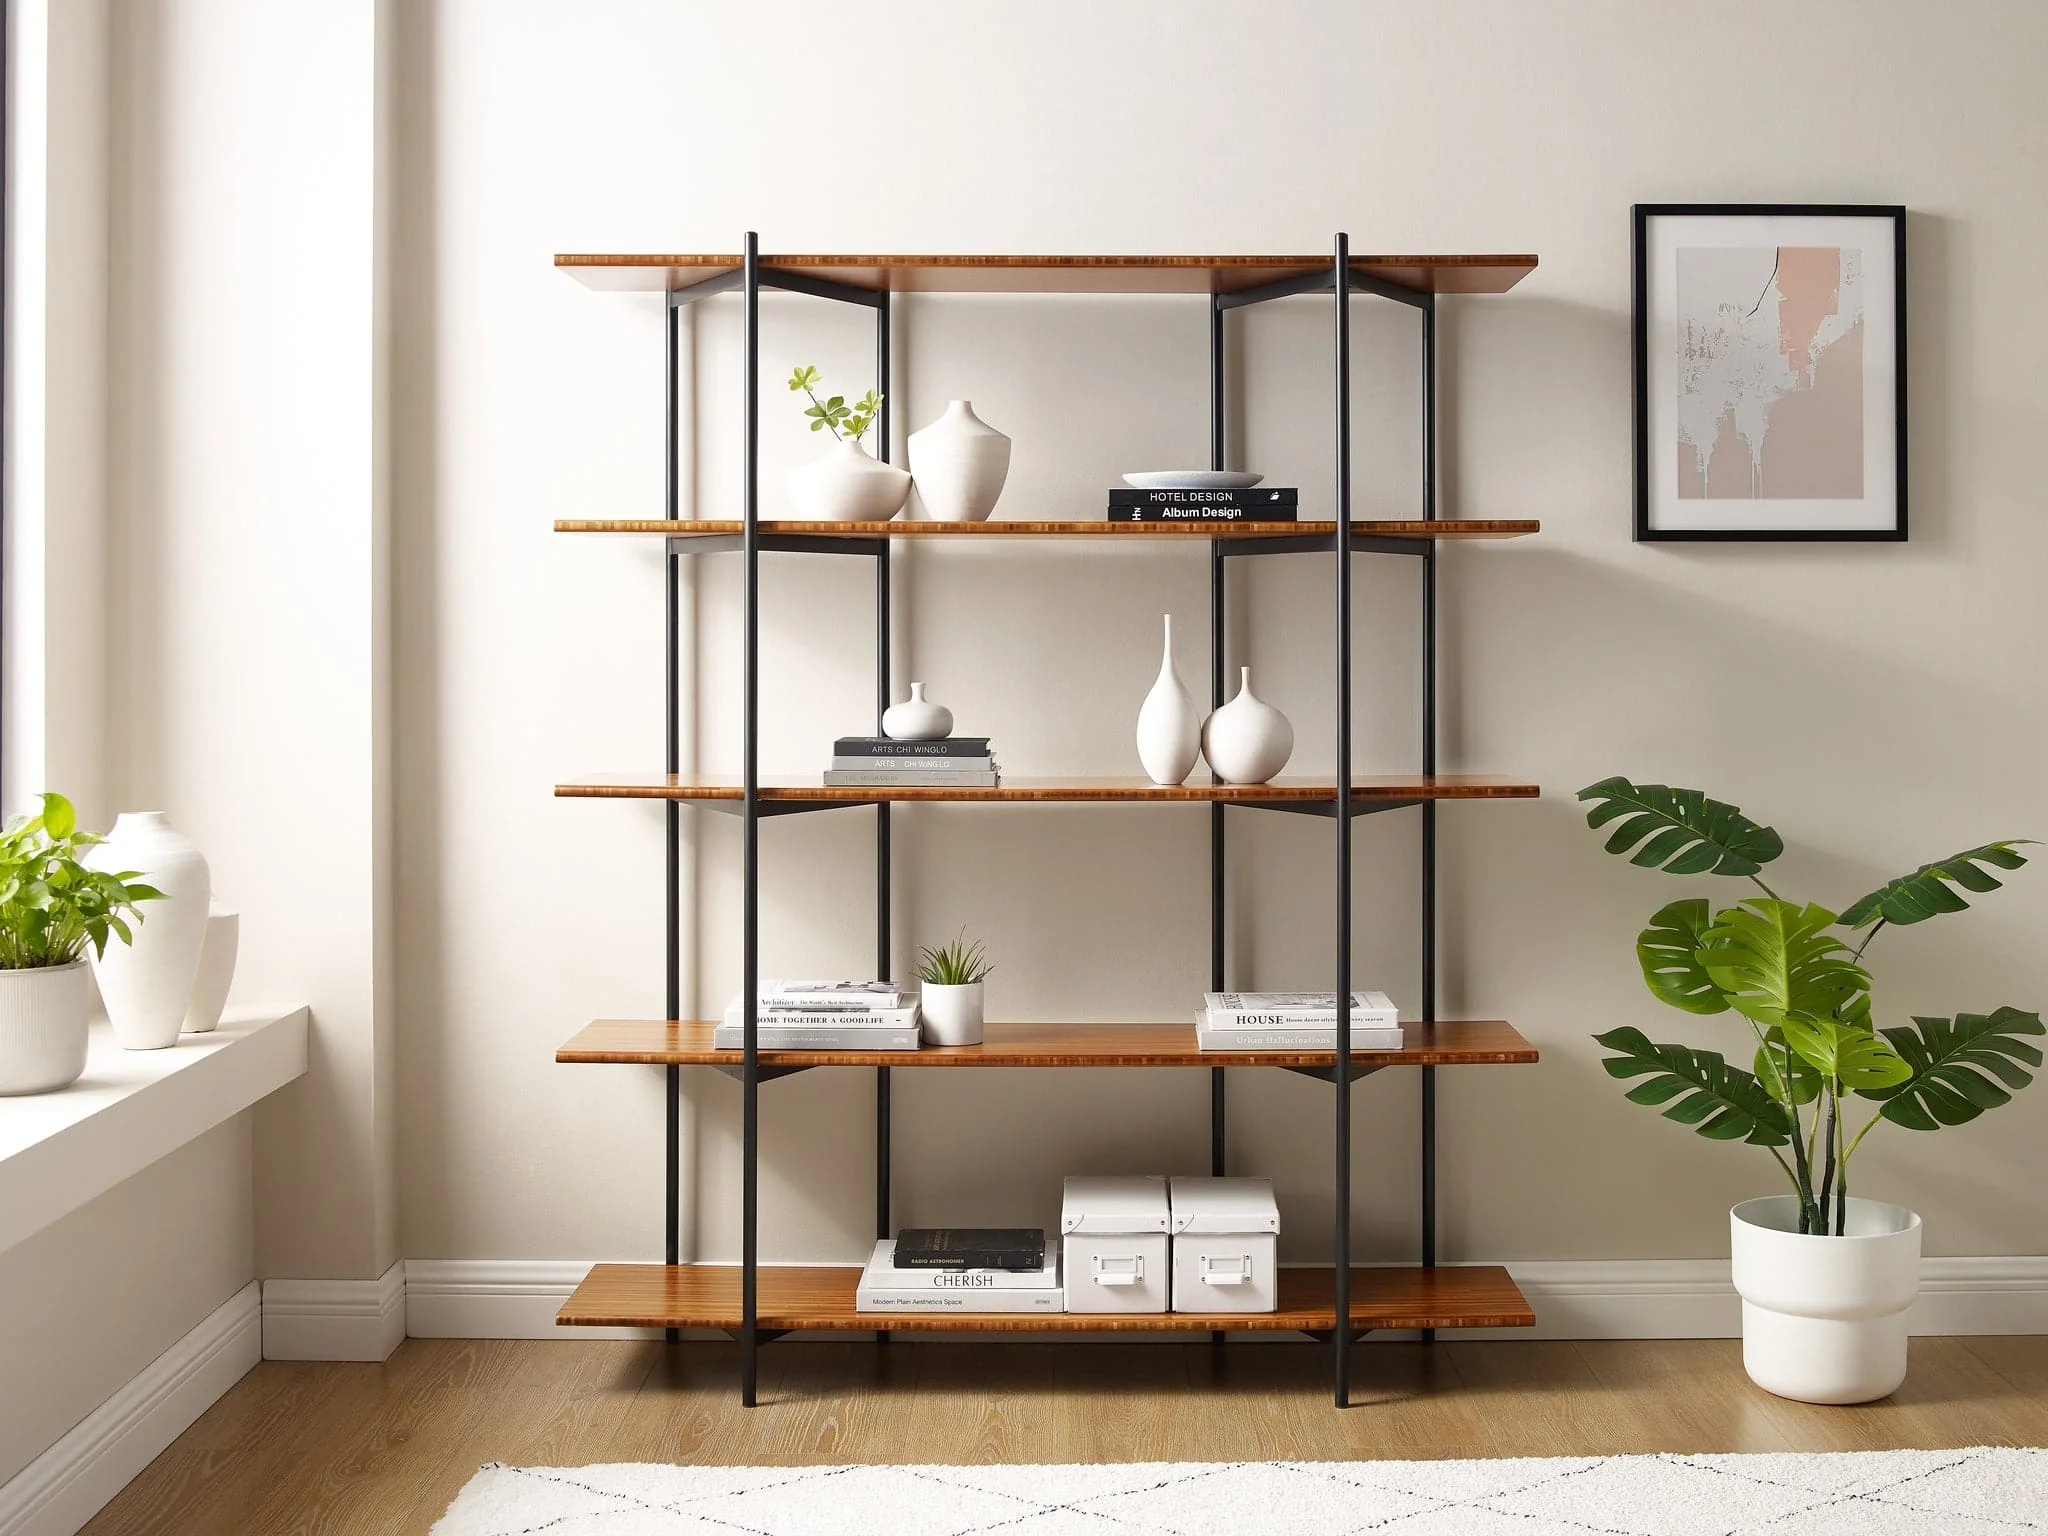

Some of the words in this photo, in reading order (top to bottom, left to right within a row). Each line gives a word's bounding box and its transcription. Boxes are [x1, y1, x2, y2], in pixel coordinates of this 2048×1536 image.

[1150, 493, 1187, 501] HOTEL
[1190, 492, 1233, 501] DESIGN
[1162, 507, 1200, 518] Album
[1202, 506, 1241, 519] Design
[1236, 1015, 1284, 1025] HOUSE
[1237, 1036, 1264, 1044] Urban
[933, 1275, 993, 1287] CHERISH
